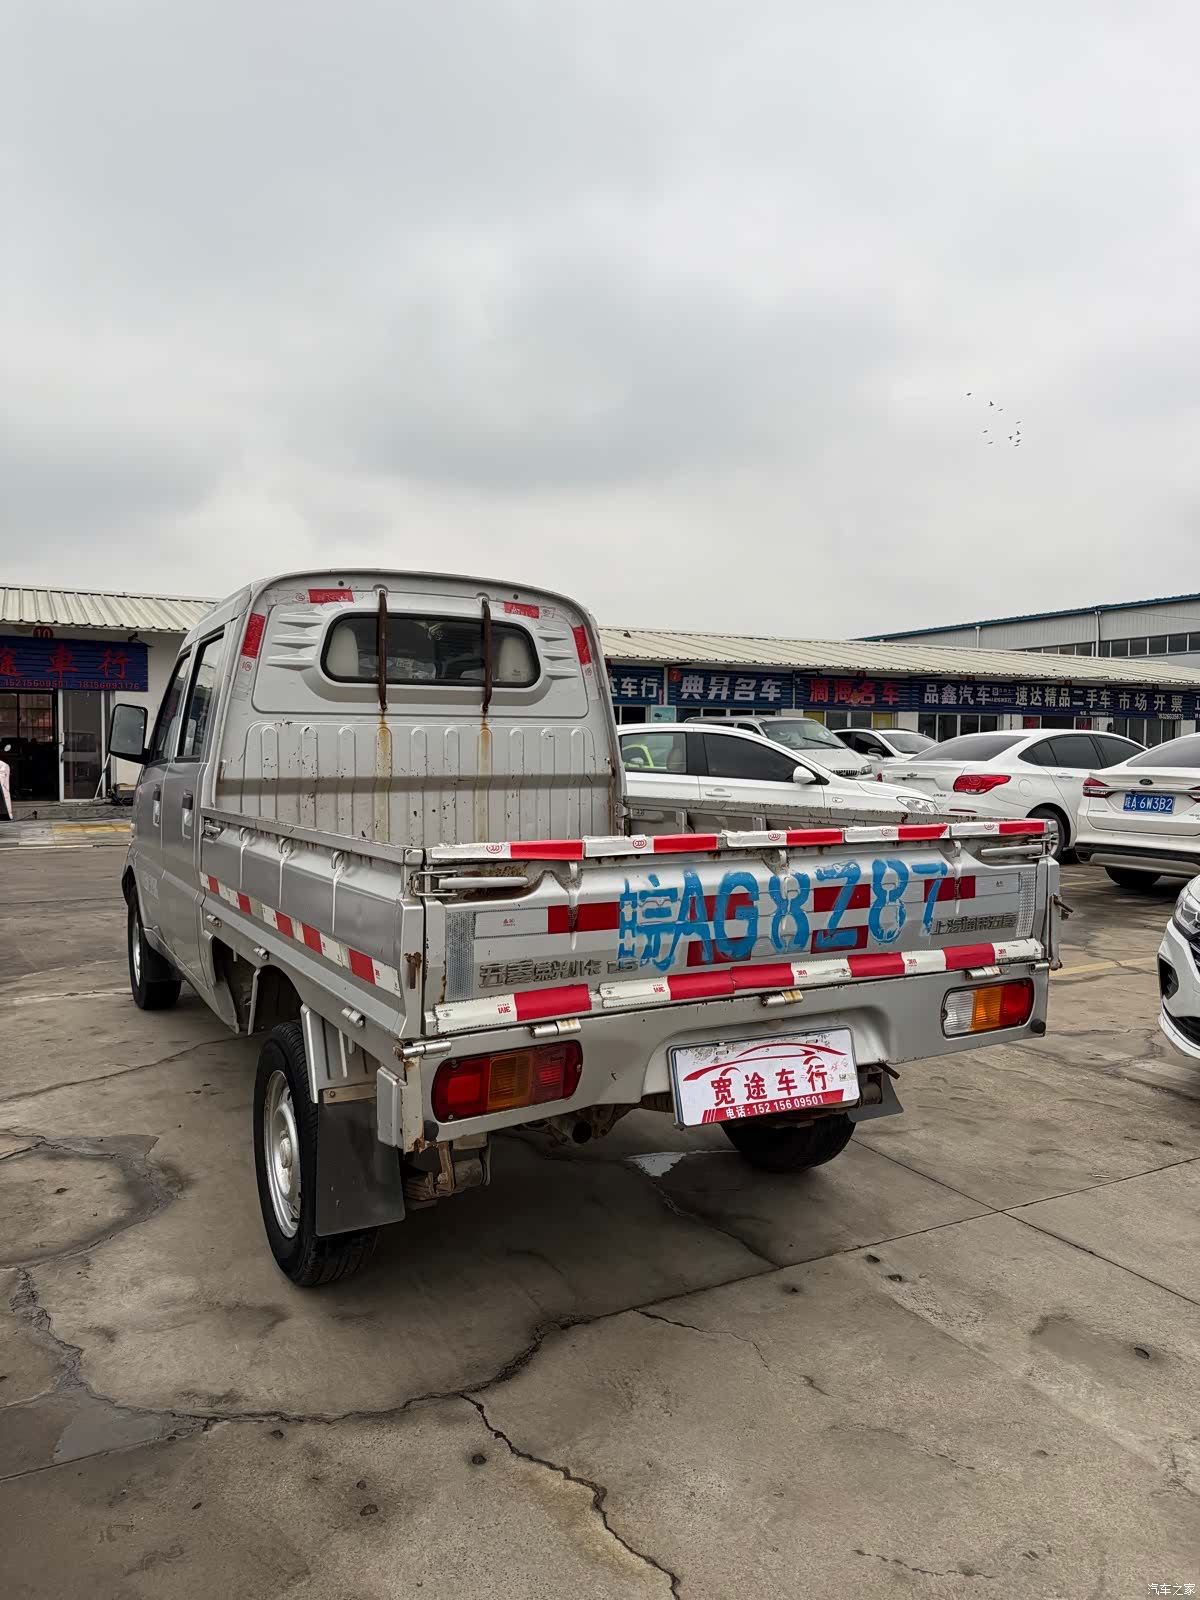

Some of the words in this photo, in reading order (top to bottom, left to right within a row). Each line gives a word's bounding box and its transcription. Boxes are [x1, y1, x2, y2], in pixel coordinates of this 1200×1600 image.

[924, 683, 991, 706] 品鑫汽车
[1015, 685, 1111, 709] 速达精品二手车
[1118, 691, 1184, 713] 市场开票
[710, 1064, 829, 1107] 宽途车行
[725, 1105, 751, 1119] 电话:
[752, 1101, 772, 1116] 152
[774, 1099, 792, 1112] 156
[794, 1094, 825, 1108] 09501
